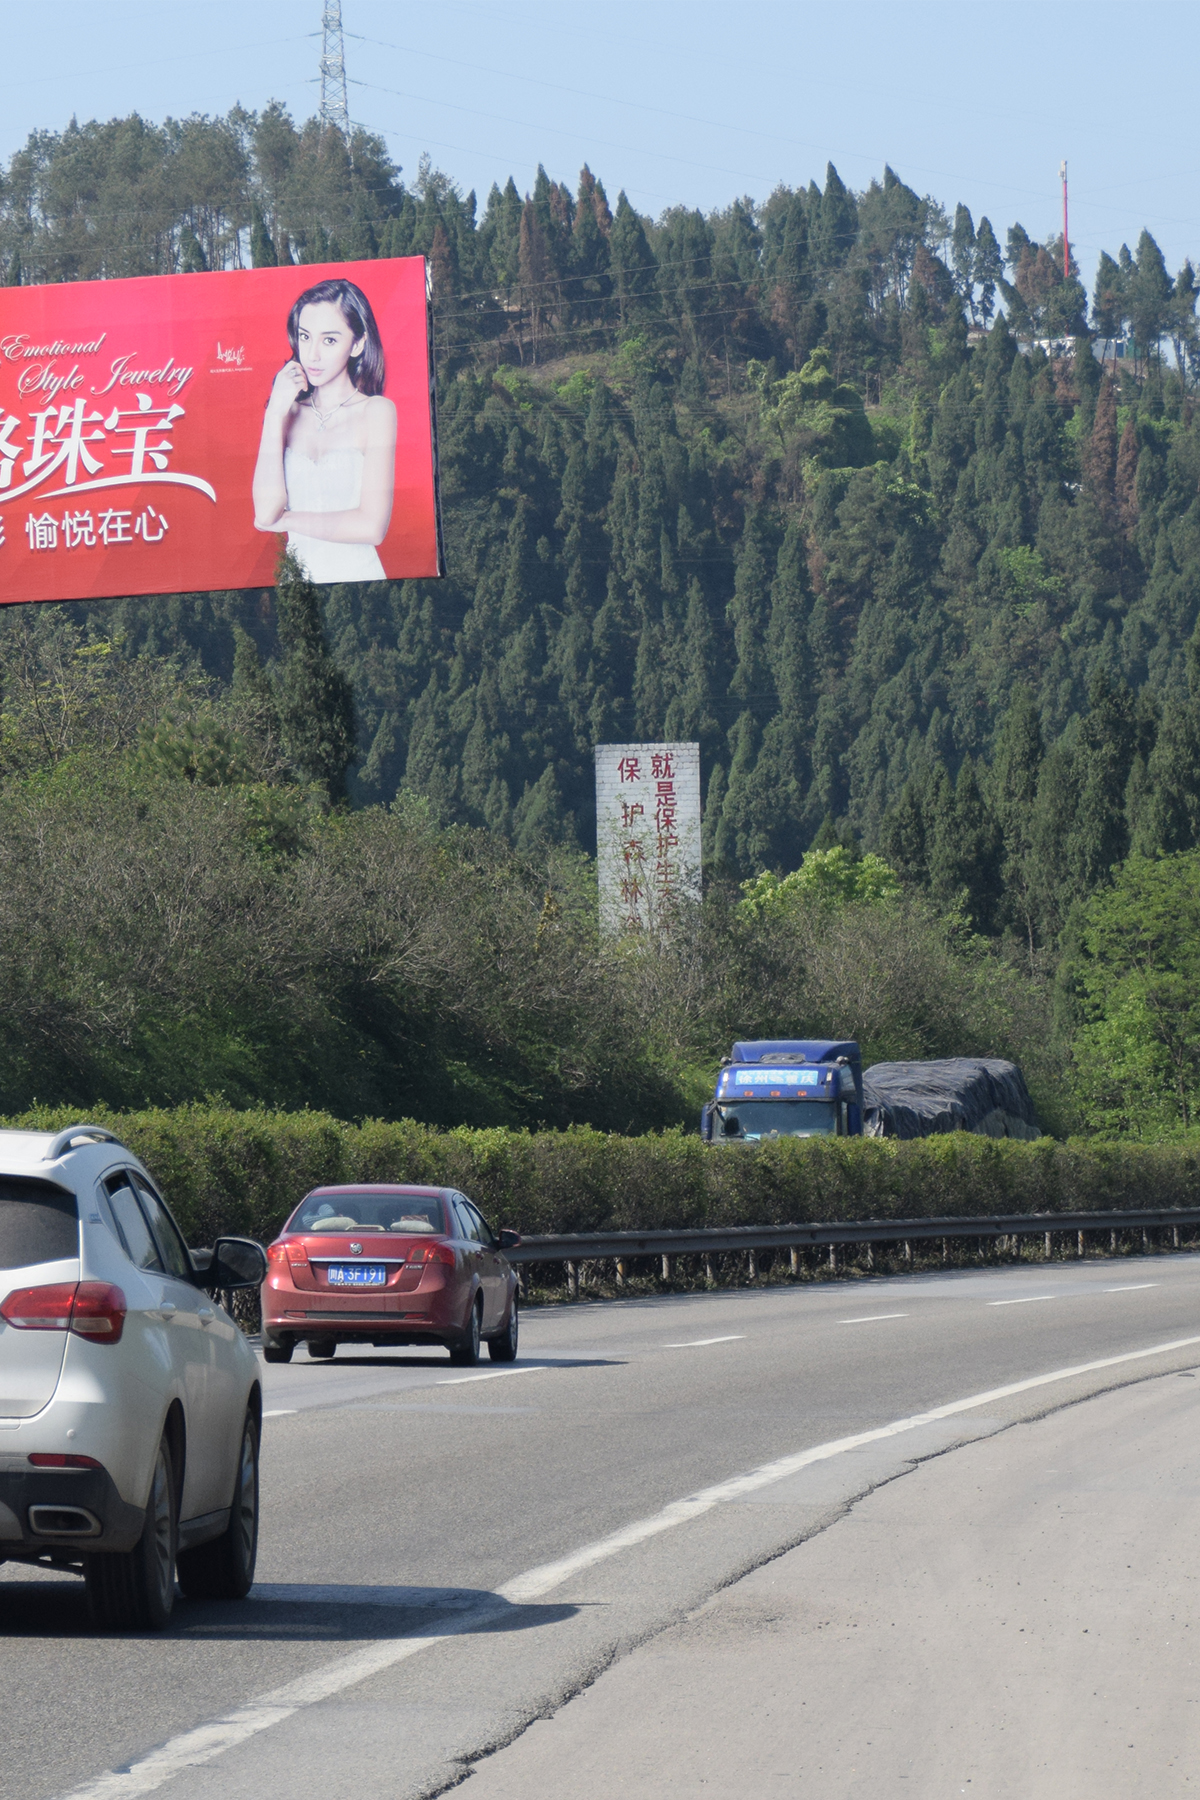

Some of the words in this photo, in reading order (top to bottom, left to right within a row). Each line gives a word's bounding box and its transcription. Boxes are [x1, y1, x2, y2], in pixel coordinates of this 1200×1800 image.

[0, 332, 107, 362] Emotional
[17, 358, 85, 406] Style
[89, 351, 195, 397] Jewelry
[25, 504, 170, 551] 愉悦在心
